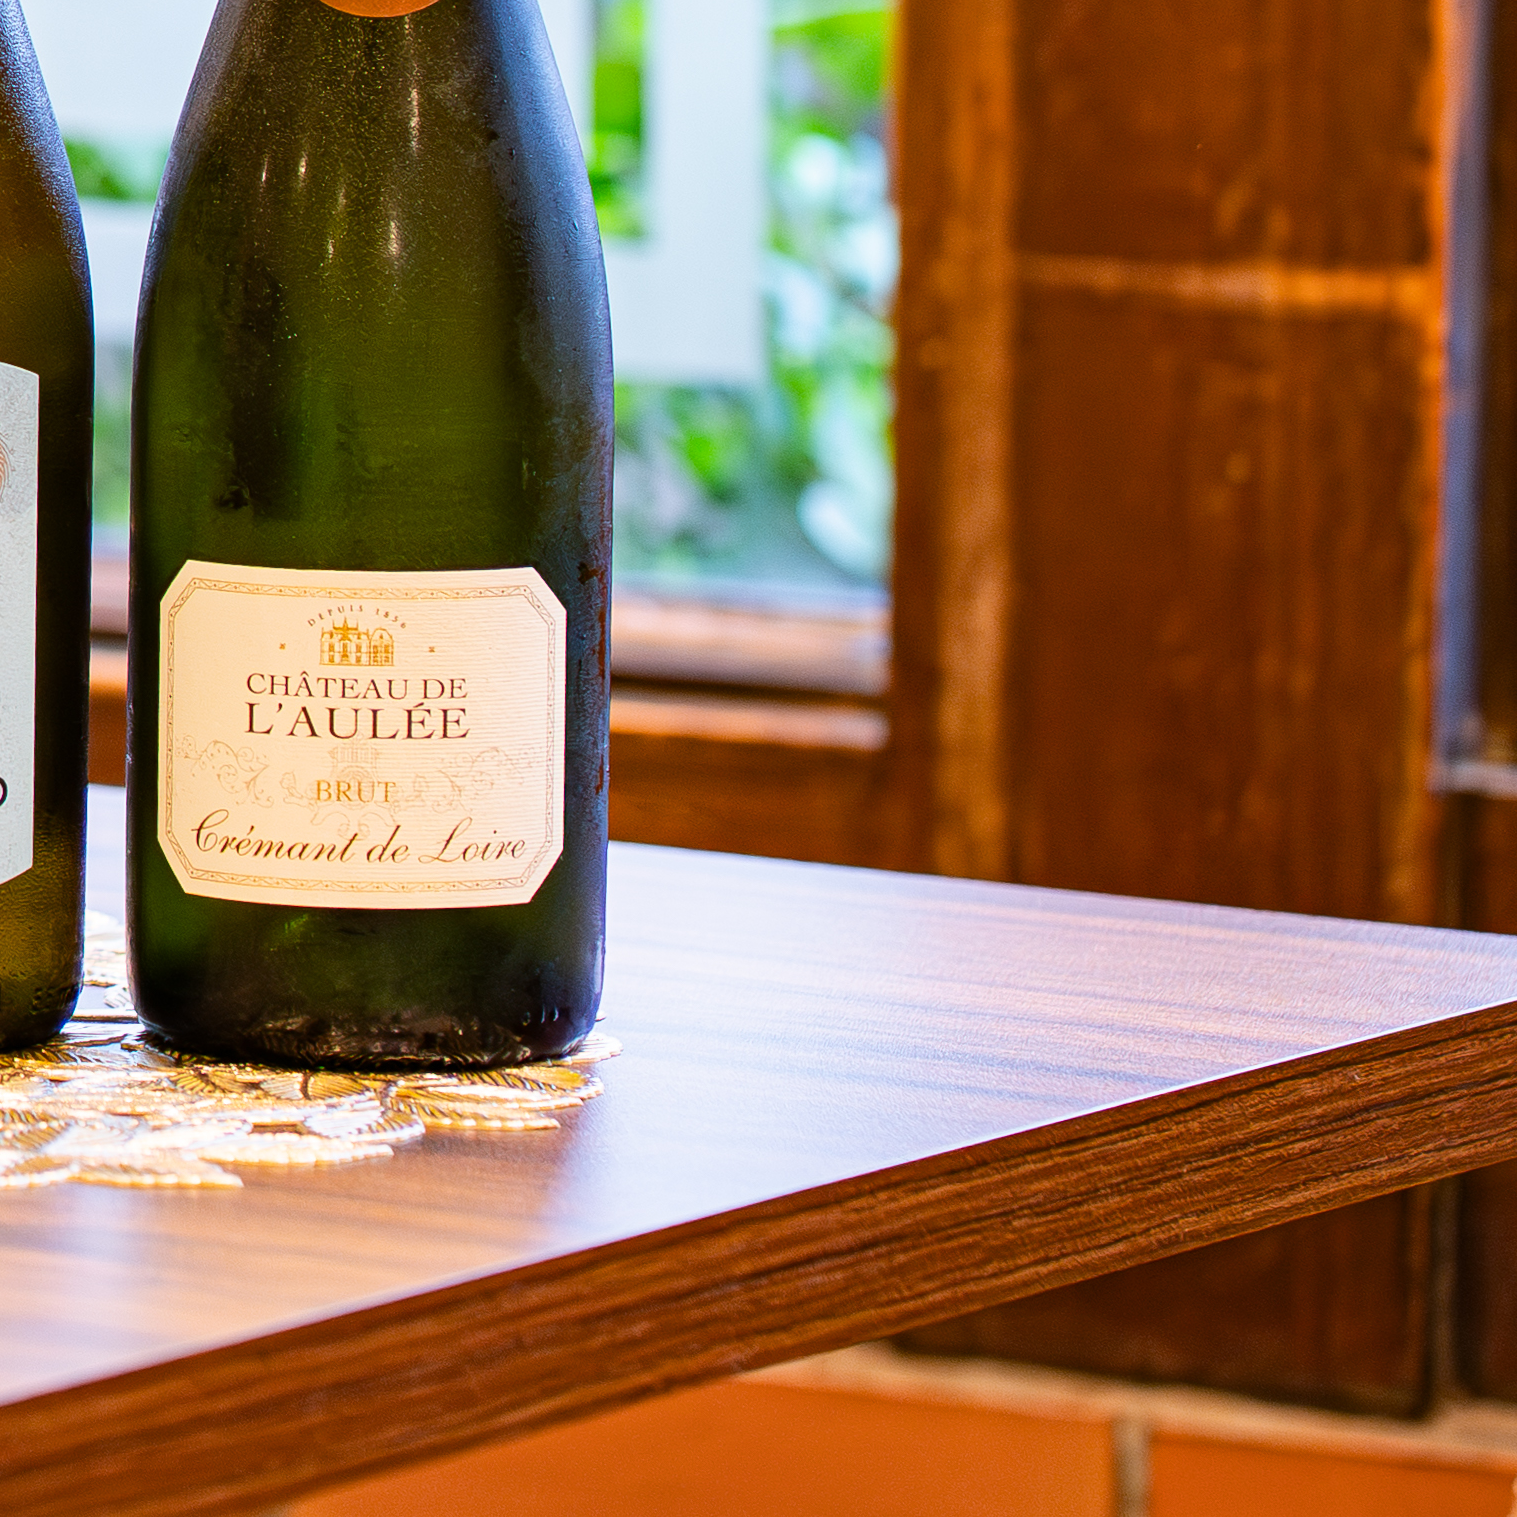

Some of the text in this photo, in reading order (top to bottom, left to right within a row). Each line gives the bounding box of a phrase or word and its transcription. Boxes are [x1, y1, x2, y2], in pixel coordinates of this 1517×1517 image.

[246, 671, 468, 700] CHÂTEAU DE
[316, 780, 395, 802] BRUT
[191, 810, 526, 863] Crémant de Loire
